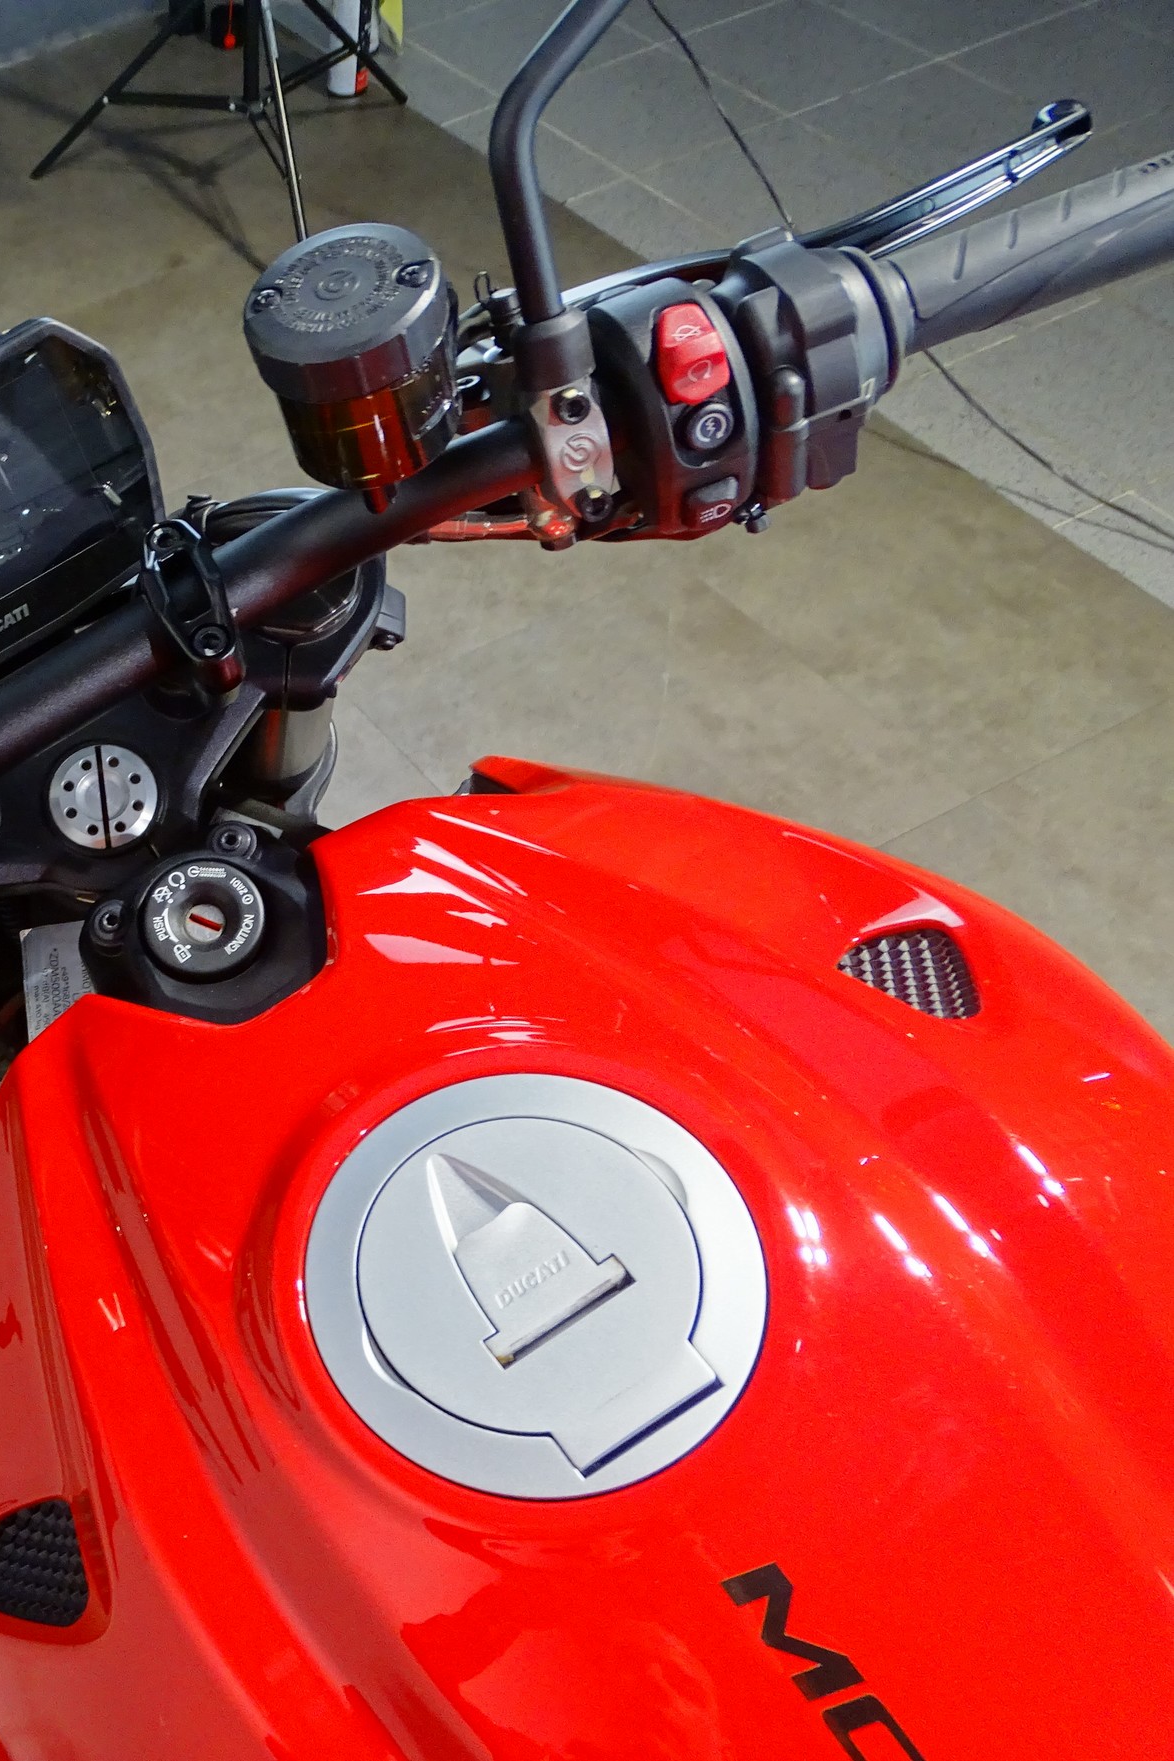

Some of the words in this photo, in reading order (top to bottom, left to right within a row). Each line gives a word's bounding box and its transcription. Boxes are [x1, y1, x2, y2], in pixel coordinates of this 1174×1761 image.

[152, 916, 169, 942] PUSH
[224, 914, 255, 956] IGNITION
[494, 1250, 570, 1309] DUCATI
